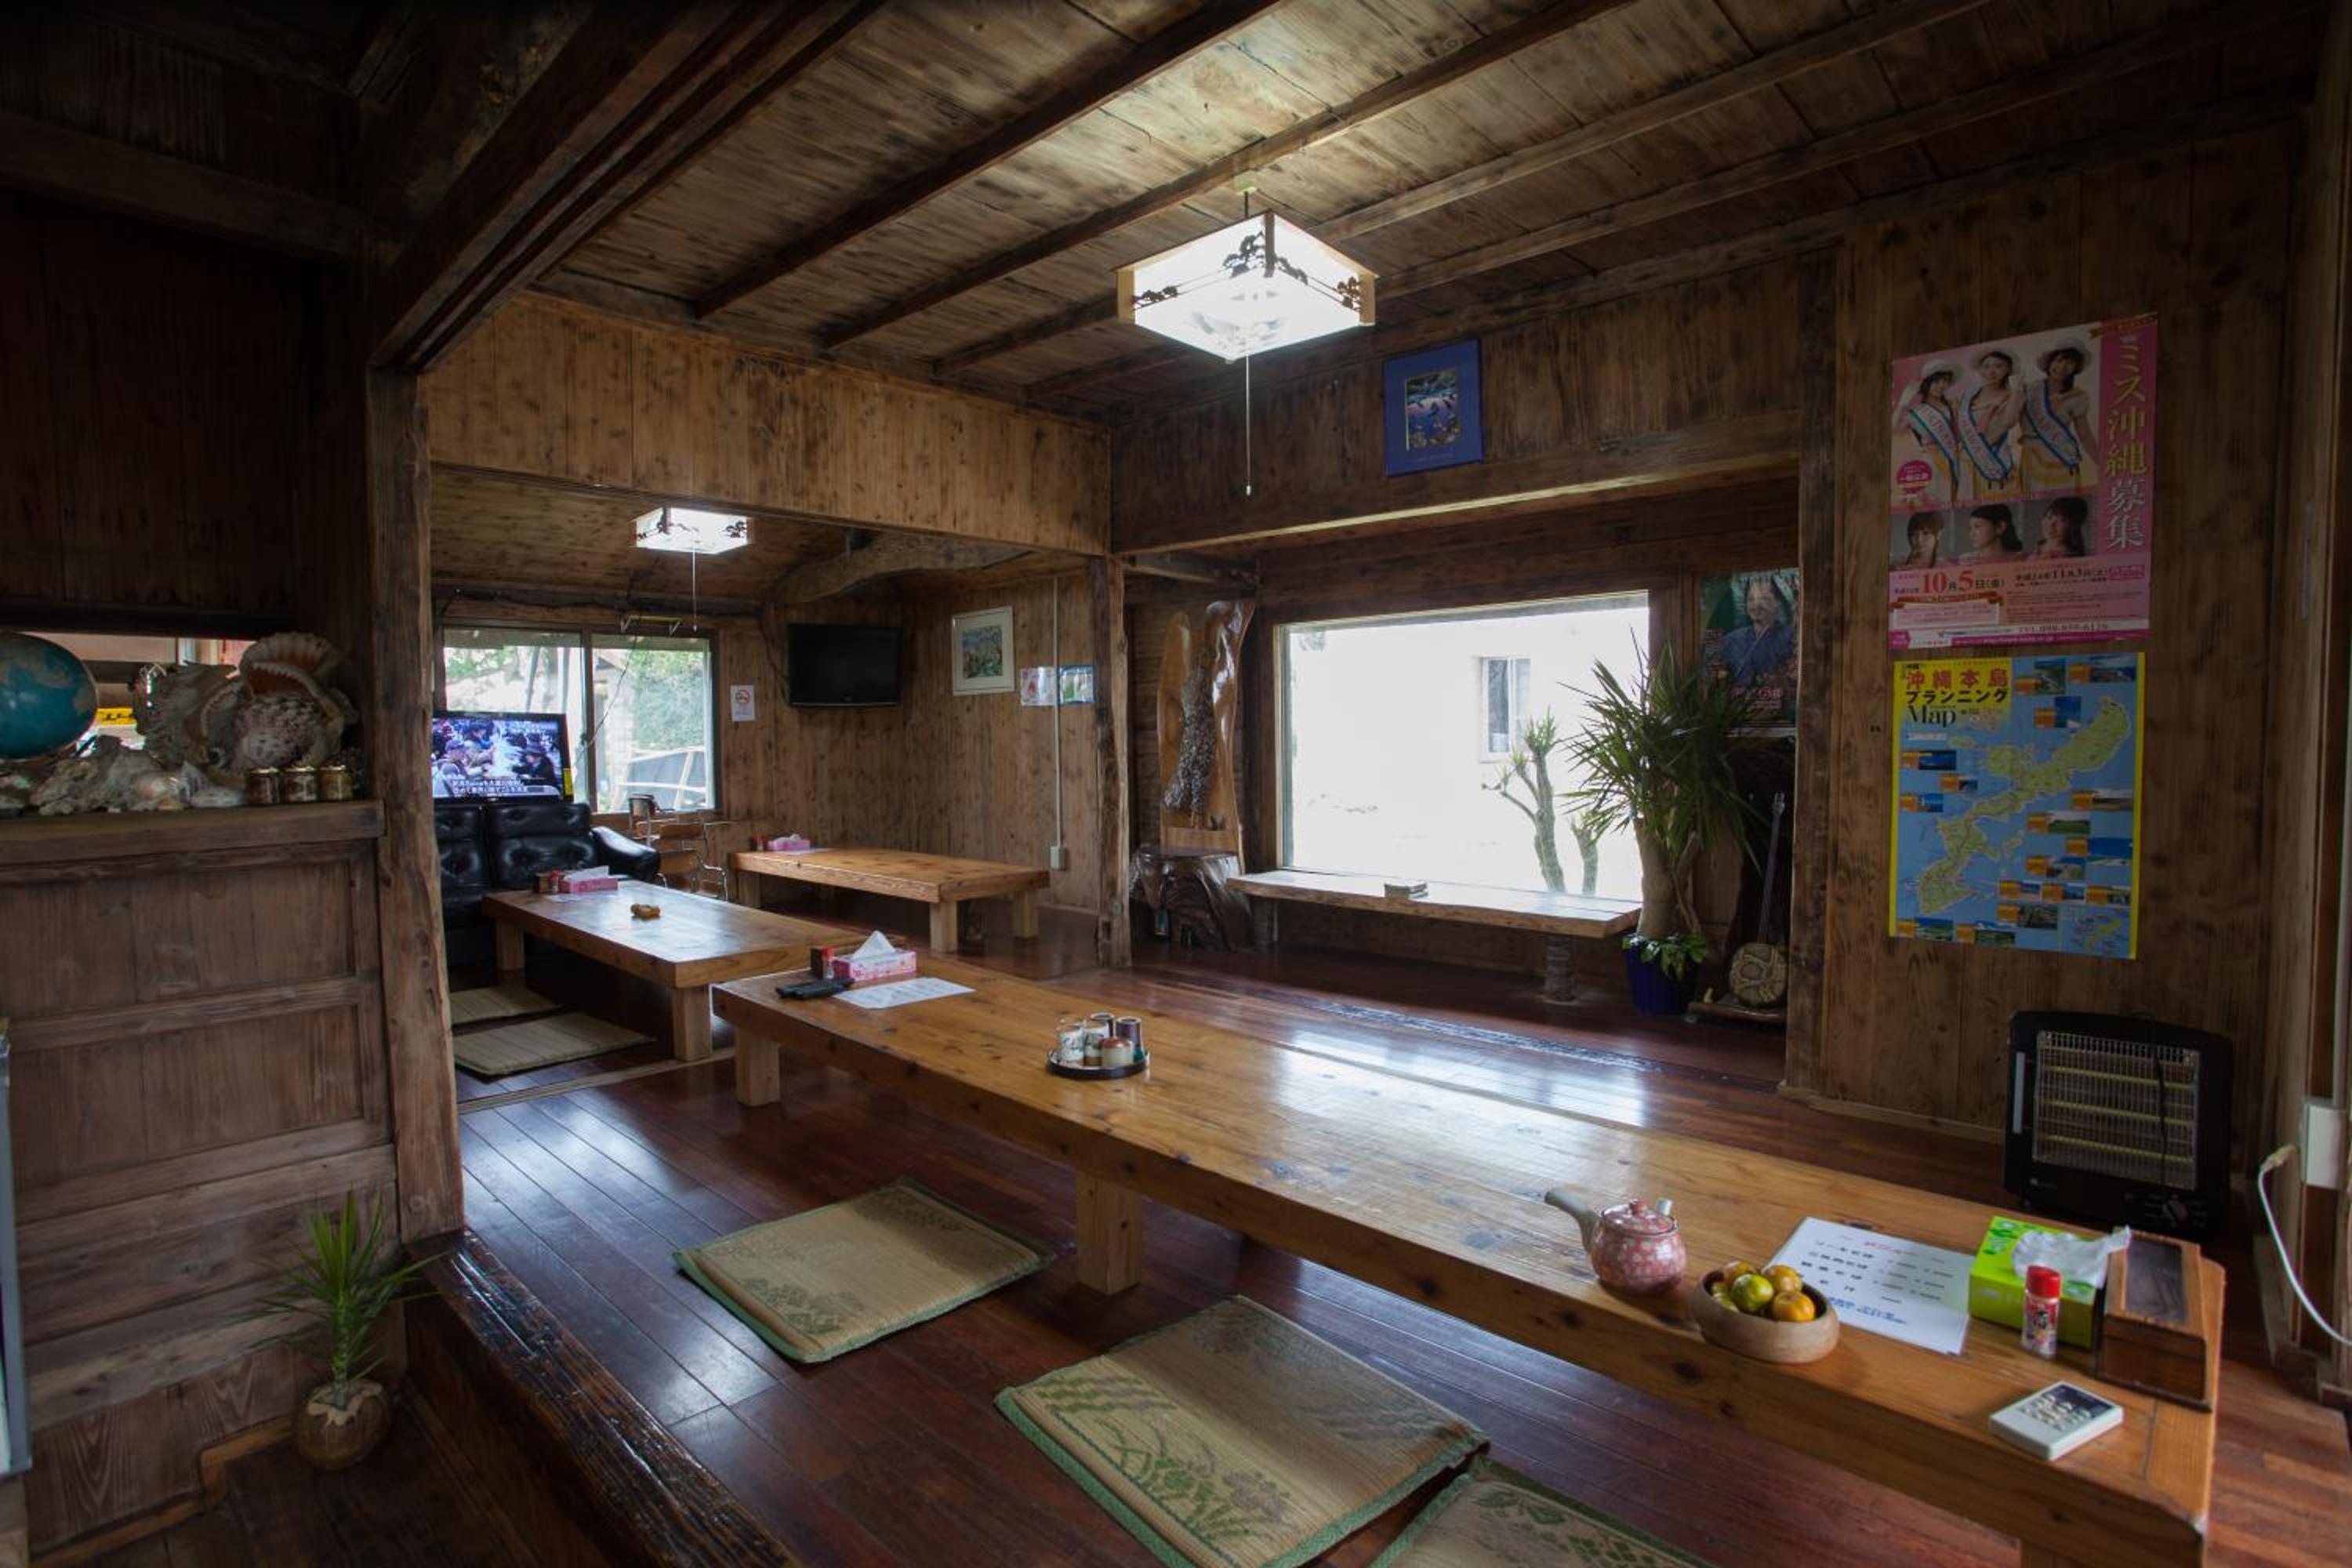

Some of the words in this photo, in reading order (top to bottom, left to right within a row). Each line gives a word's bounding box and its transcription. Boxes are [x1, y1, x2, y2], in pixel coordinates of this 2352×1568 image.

[2107, 344, 2147, 550] ミス沖縄募集
[1907, 668, 2008, 690] 沖縄本島
[1906, 688, 2009, 704] プランニング
[1907, 705, 1956, 728] Map
